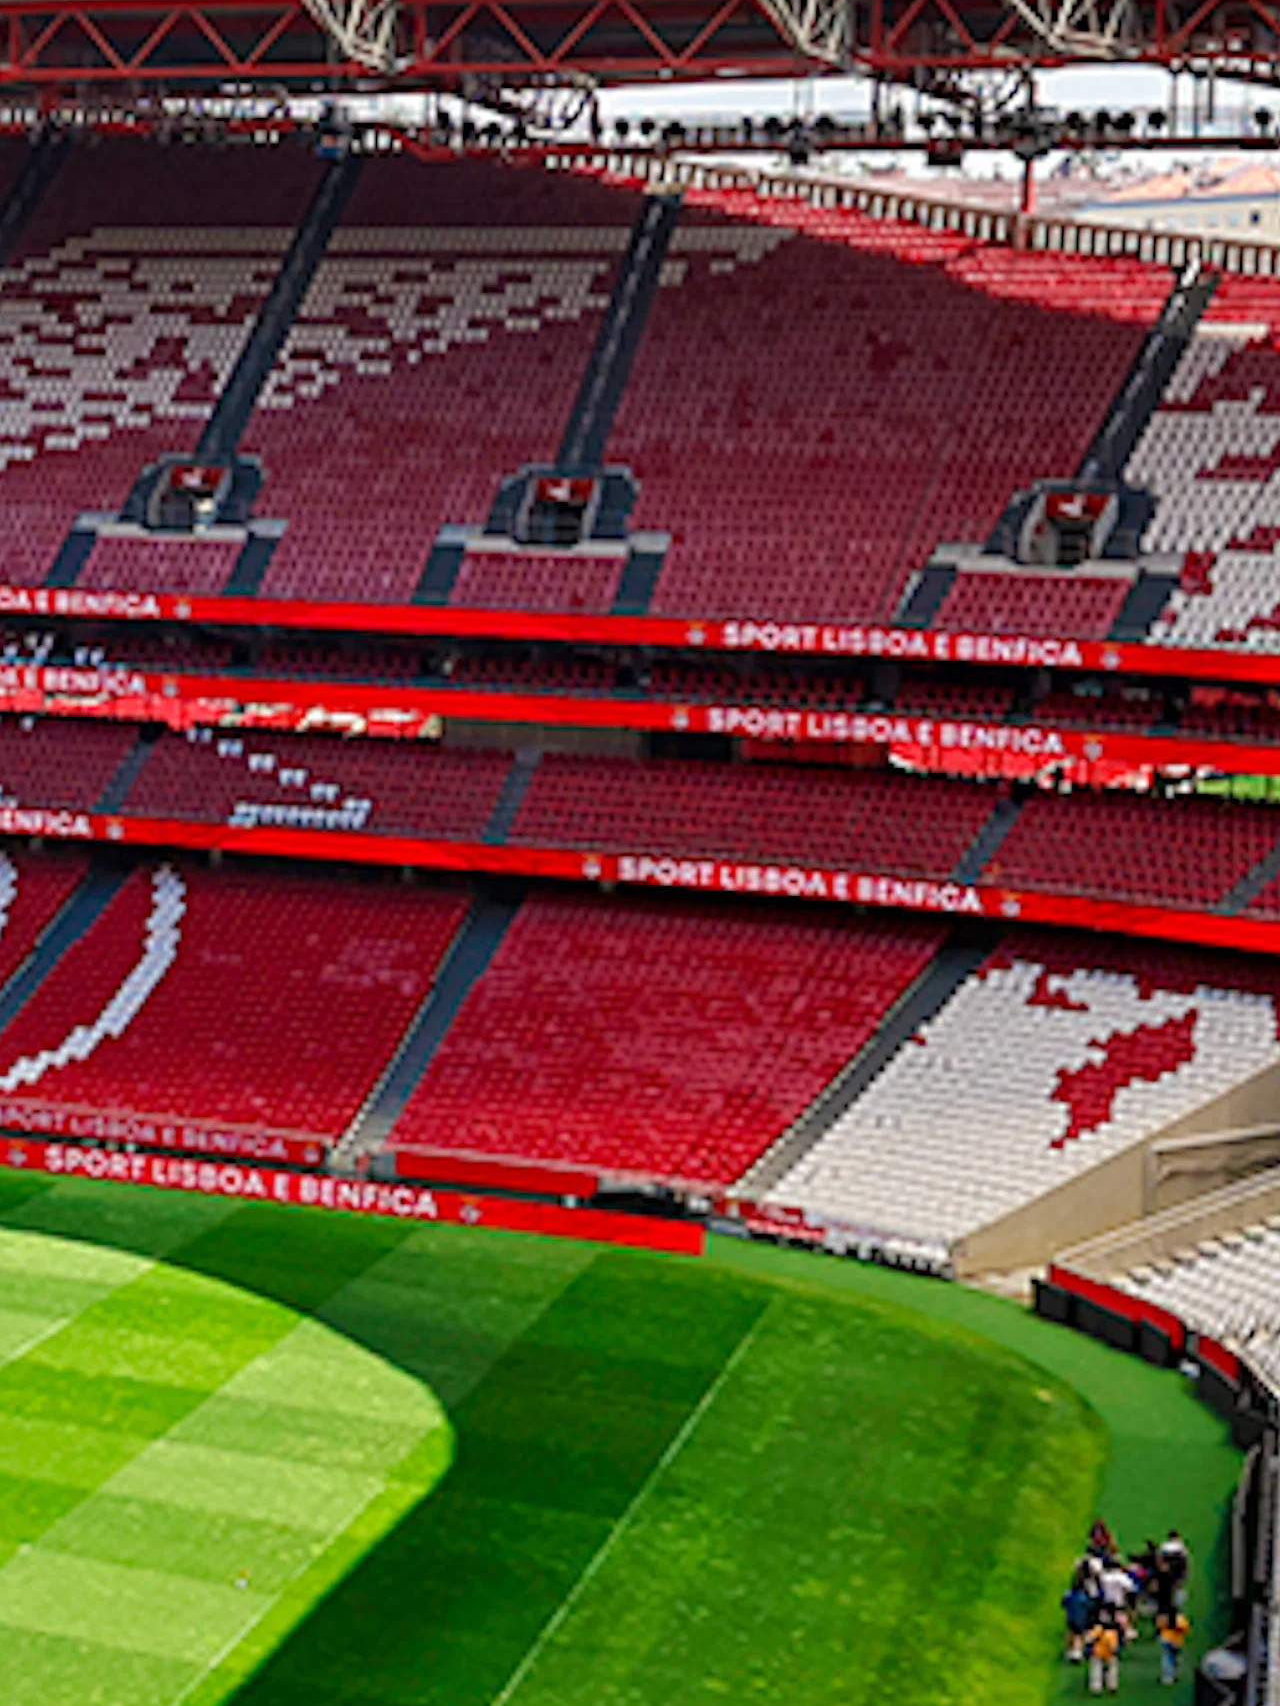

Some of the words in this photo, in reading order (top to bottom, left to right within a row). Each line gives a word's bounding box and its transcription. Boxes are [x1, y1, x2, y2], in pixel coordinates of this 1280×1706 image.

[35, 590, 47, 612] E
[54, 588, 161, 618] BENFICA
[724, 621, 815, 651] SPORT
[822, 625, 928, 657] LISBOA
[936, 635, 949, 657] E
[956, 634, 1083, 666] BENFICA
[24, 665, 37, 687] E
[44, 667, 145, 694] BENFICA
[708, 707, 800, 736] SPORT
[807, 712, 912, 743] LISBOA
[919, 721, 933, 745] E
[939, 721, 1063, 755] BENFICA
[618, 856, 713, 885] SPORT
[720, 865, 827, 896] LISBOA
[833, 877, 848, 899] E
[857, 878, 983, 913] BENFICA
[162, 1124, 176, 1145] E
[184, 1127, 286, 1158] BENFICA
[45, 1145, 143, 1181] SPORT
[152, 1158, 267, 1197] LISBOA
[274, 1171, 290, 1200] E
[300, 1174, 438, 1219] BENFICA
